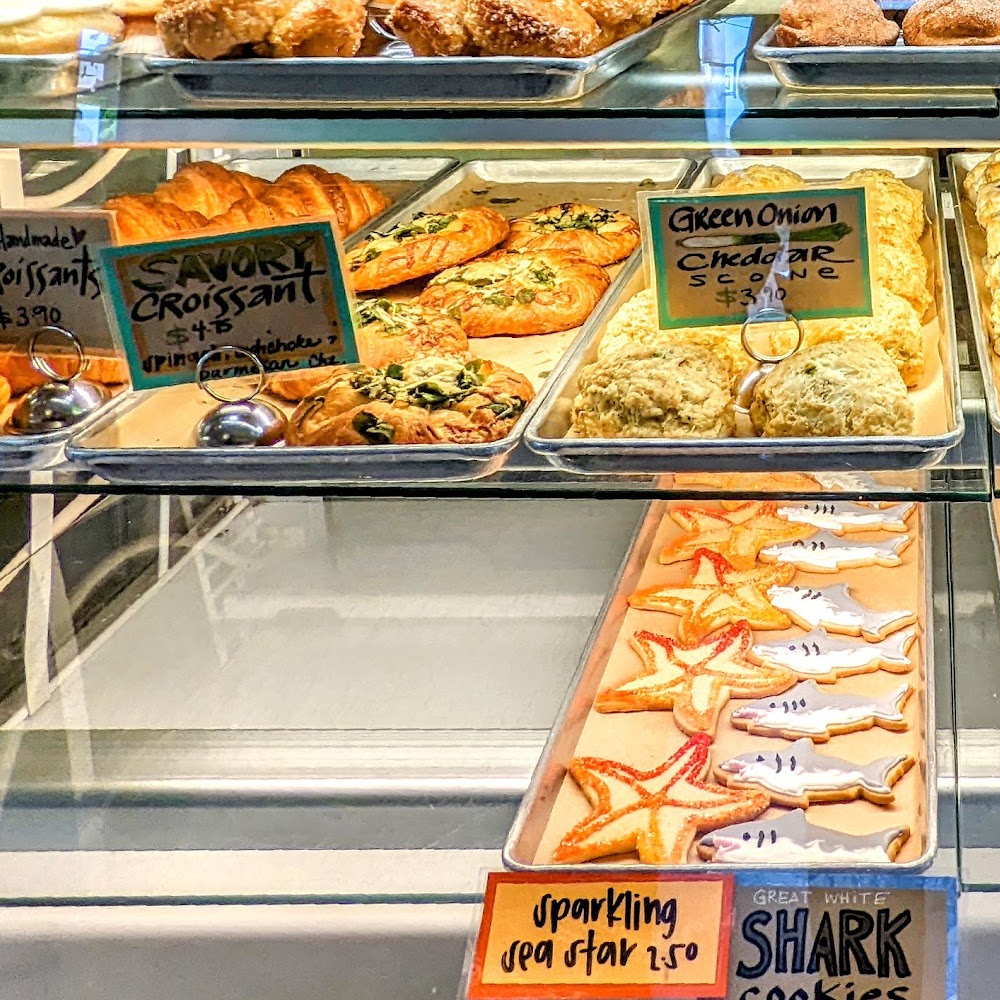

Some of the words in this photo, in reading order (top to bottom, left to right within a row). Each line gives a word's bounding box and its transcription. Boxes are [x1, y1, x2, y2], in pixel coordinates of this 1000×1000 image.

[757, 202, 838, 228] Onion
[753, 889, 812, 905] GREAT
[736, 907, 913, 979] SHARK
